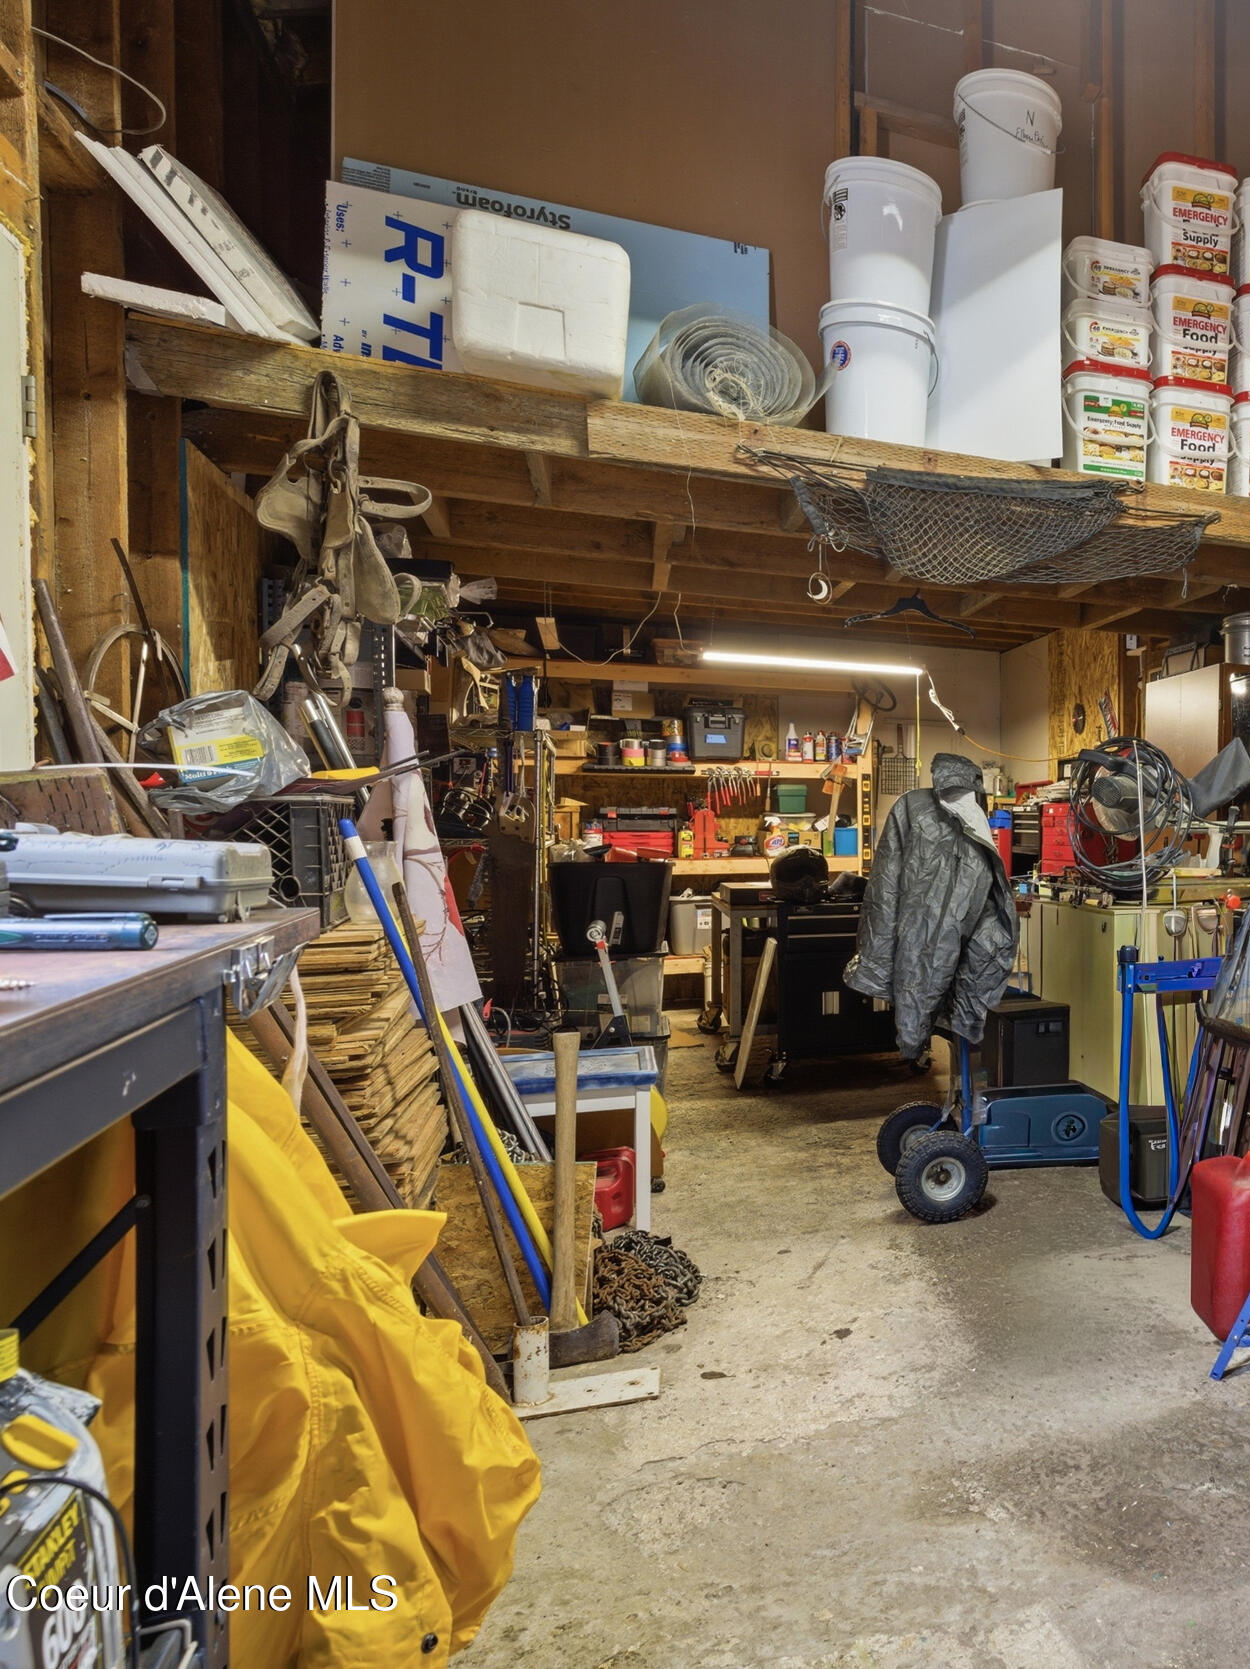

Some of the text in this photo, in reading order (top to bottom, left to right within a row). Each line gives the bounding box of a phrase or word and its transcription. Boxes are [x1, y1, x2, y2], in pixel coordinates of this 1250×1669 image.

[1026, 110, 1035, 127] N
[335, 203, 347, 233] Uses:
[455, 190, 571, 230] Styrofoam
[1172, 207, 1228, 226] EMERGENCY
[1182, 231, 1219, 248] Supply
[1173, 316, 1228, 334] EMERGENCY
[1182, 328, 1219, 344] Food
[1087, 415, 1142, 430] Emergency Food Supply
[1171, 427, 1225, 444] EMERGENCY
[1180, 439, 1216, 452] Food
